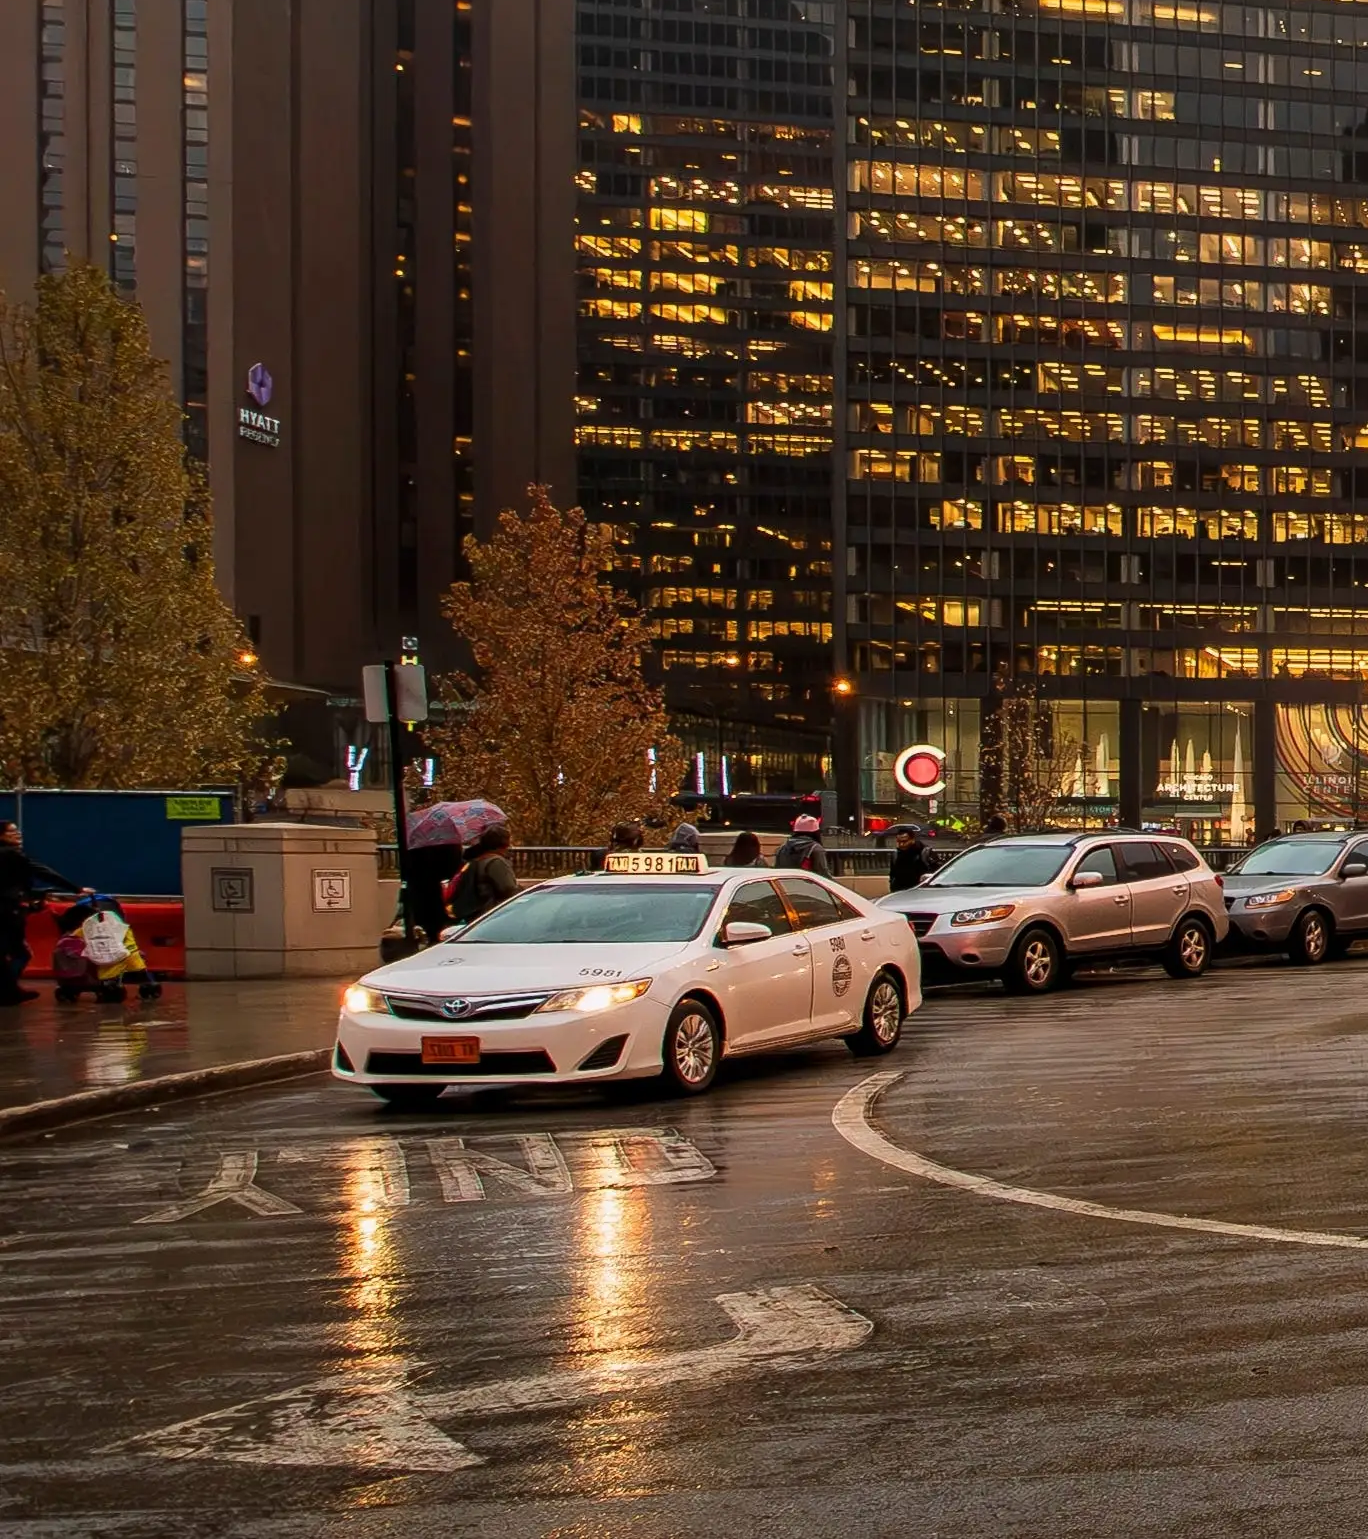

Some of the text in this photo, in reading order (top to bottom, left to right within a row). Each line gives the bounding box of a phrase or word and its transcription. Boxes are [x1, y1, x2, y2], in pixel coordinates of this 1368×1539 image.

[239, 408, 280, 434] HYATT
[1156, 783, 1241, 792] ARCHITECTURE
[608, 856, 698, 872] TAXI 5981 TAXI
[578, 968, 623, 978] 5981
